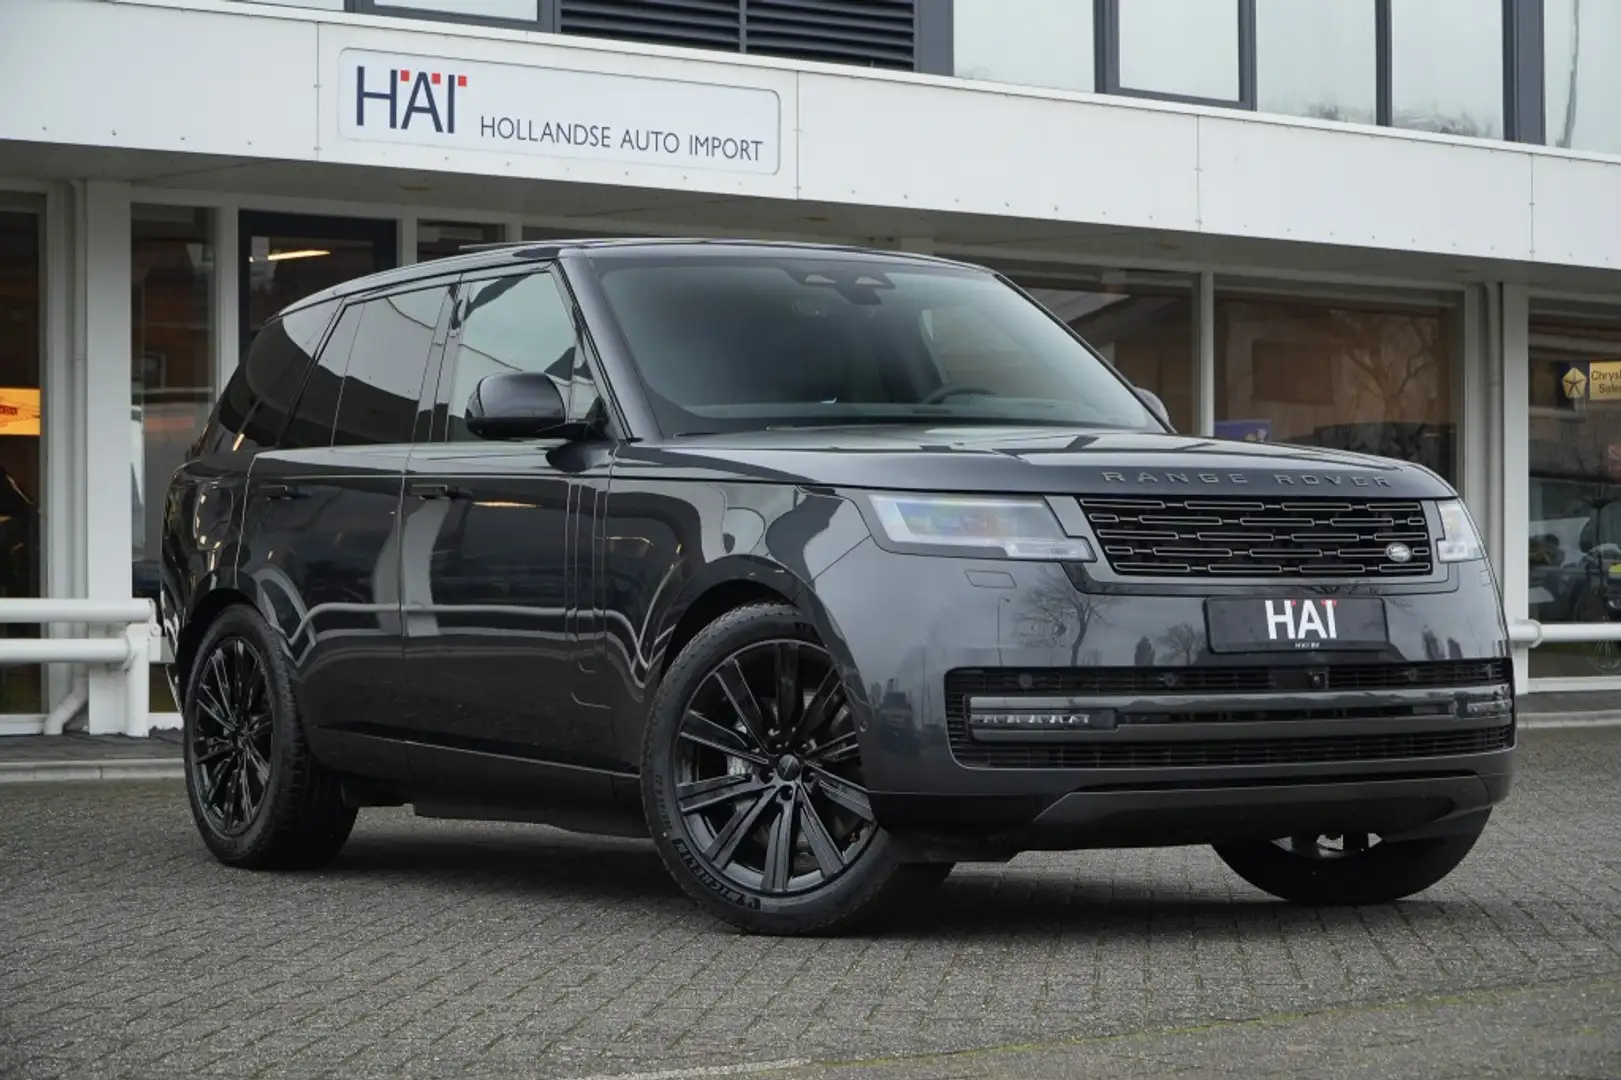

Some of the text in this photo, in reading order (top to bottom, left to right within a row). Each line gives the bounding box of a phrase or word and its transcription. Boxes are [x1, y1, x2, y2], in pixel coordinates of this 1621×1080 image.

[481, 115, 763, 161] HOLLANDSE AUTO IMPORT
[1101, 471, 1391, 488] RANGE ROVER
